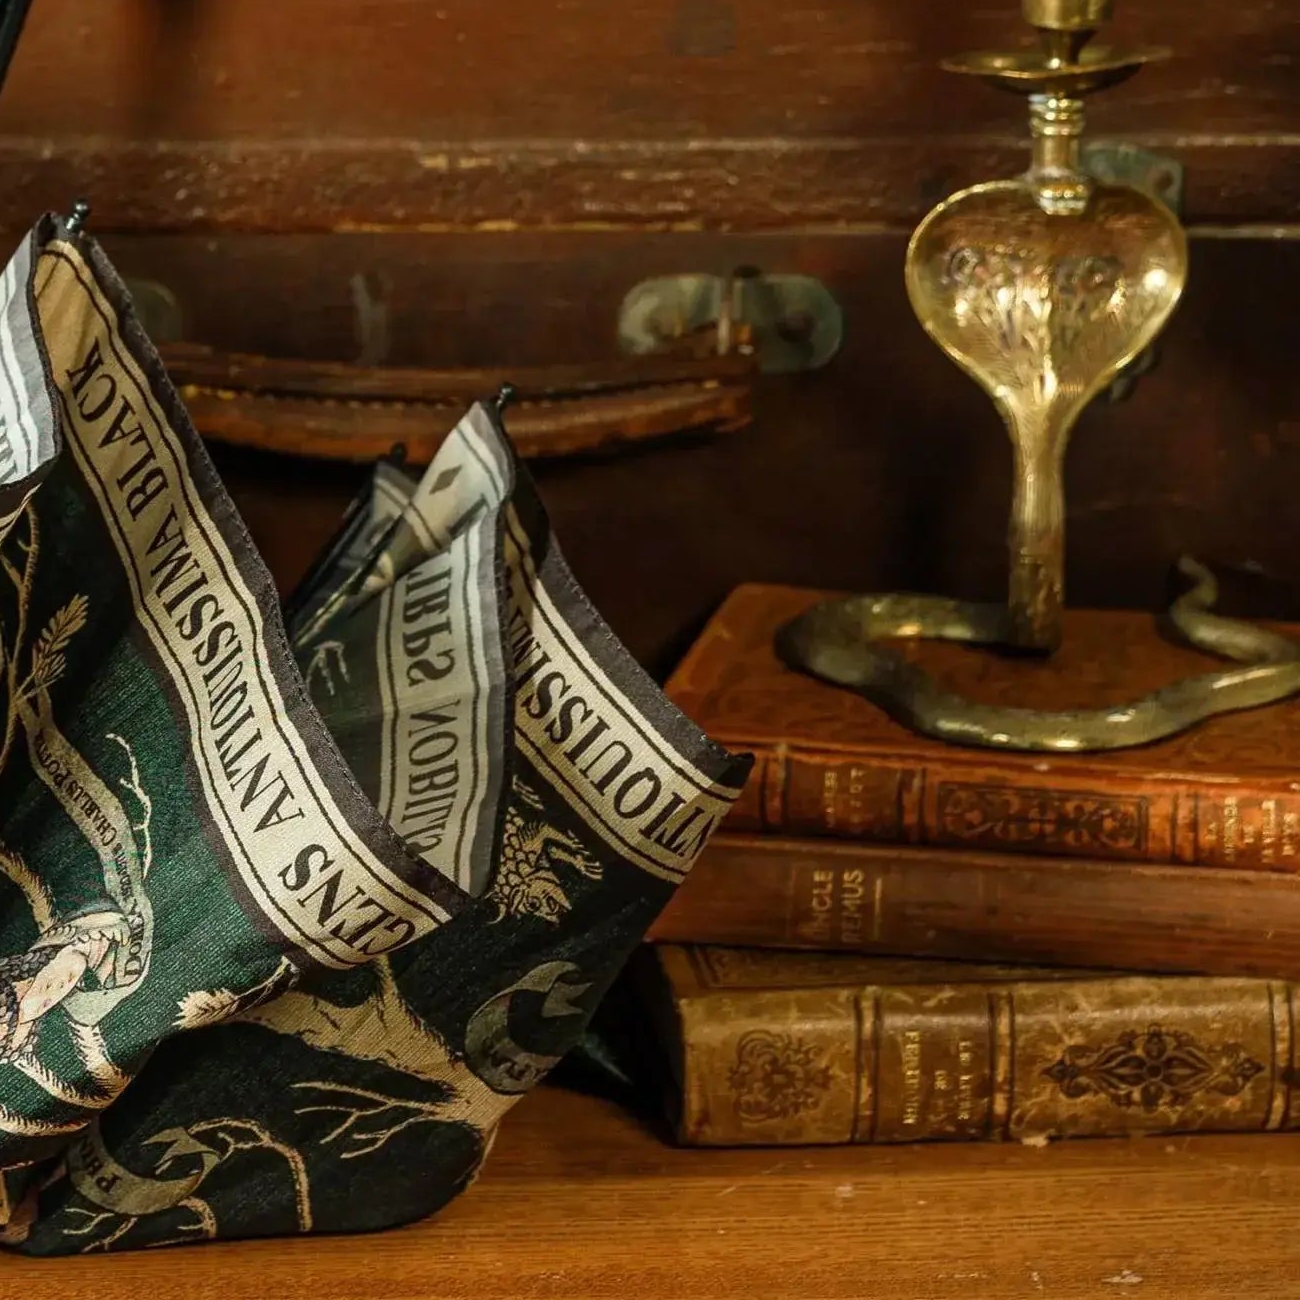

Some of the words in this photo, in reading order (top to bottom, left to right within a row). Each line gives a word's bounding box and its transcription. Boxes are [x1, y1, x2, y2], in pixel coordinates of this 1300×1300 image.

[65, 336, 172, 529] BLACK
[146, 515, 304, 833] ANTIQUISSIMA
[277, 841, 417, 958] GENS
[841, 868, 865, 944] REMUS
